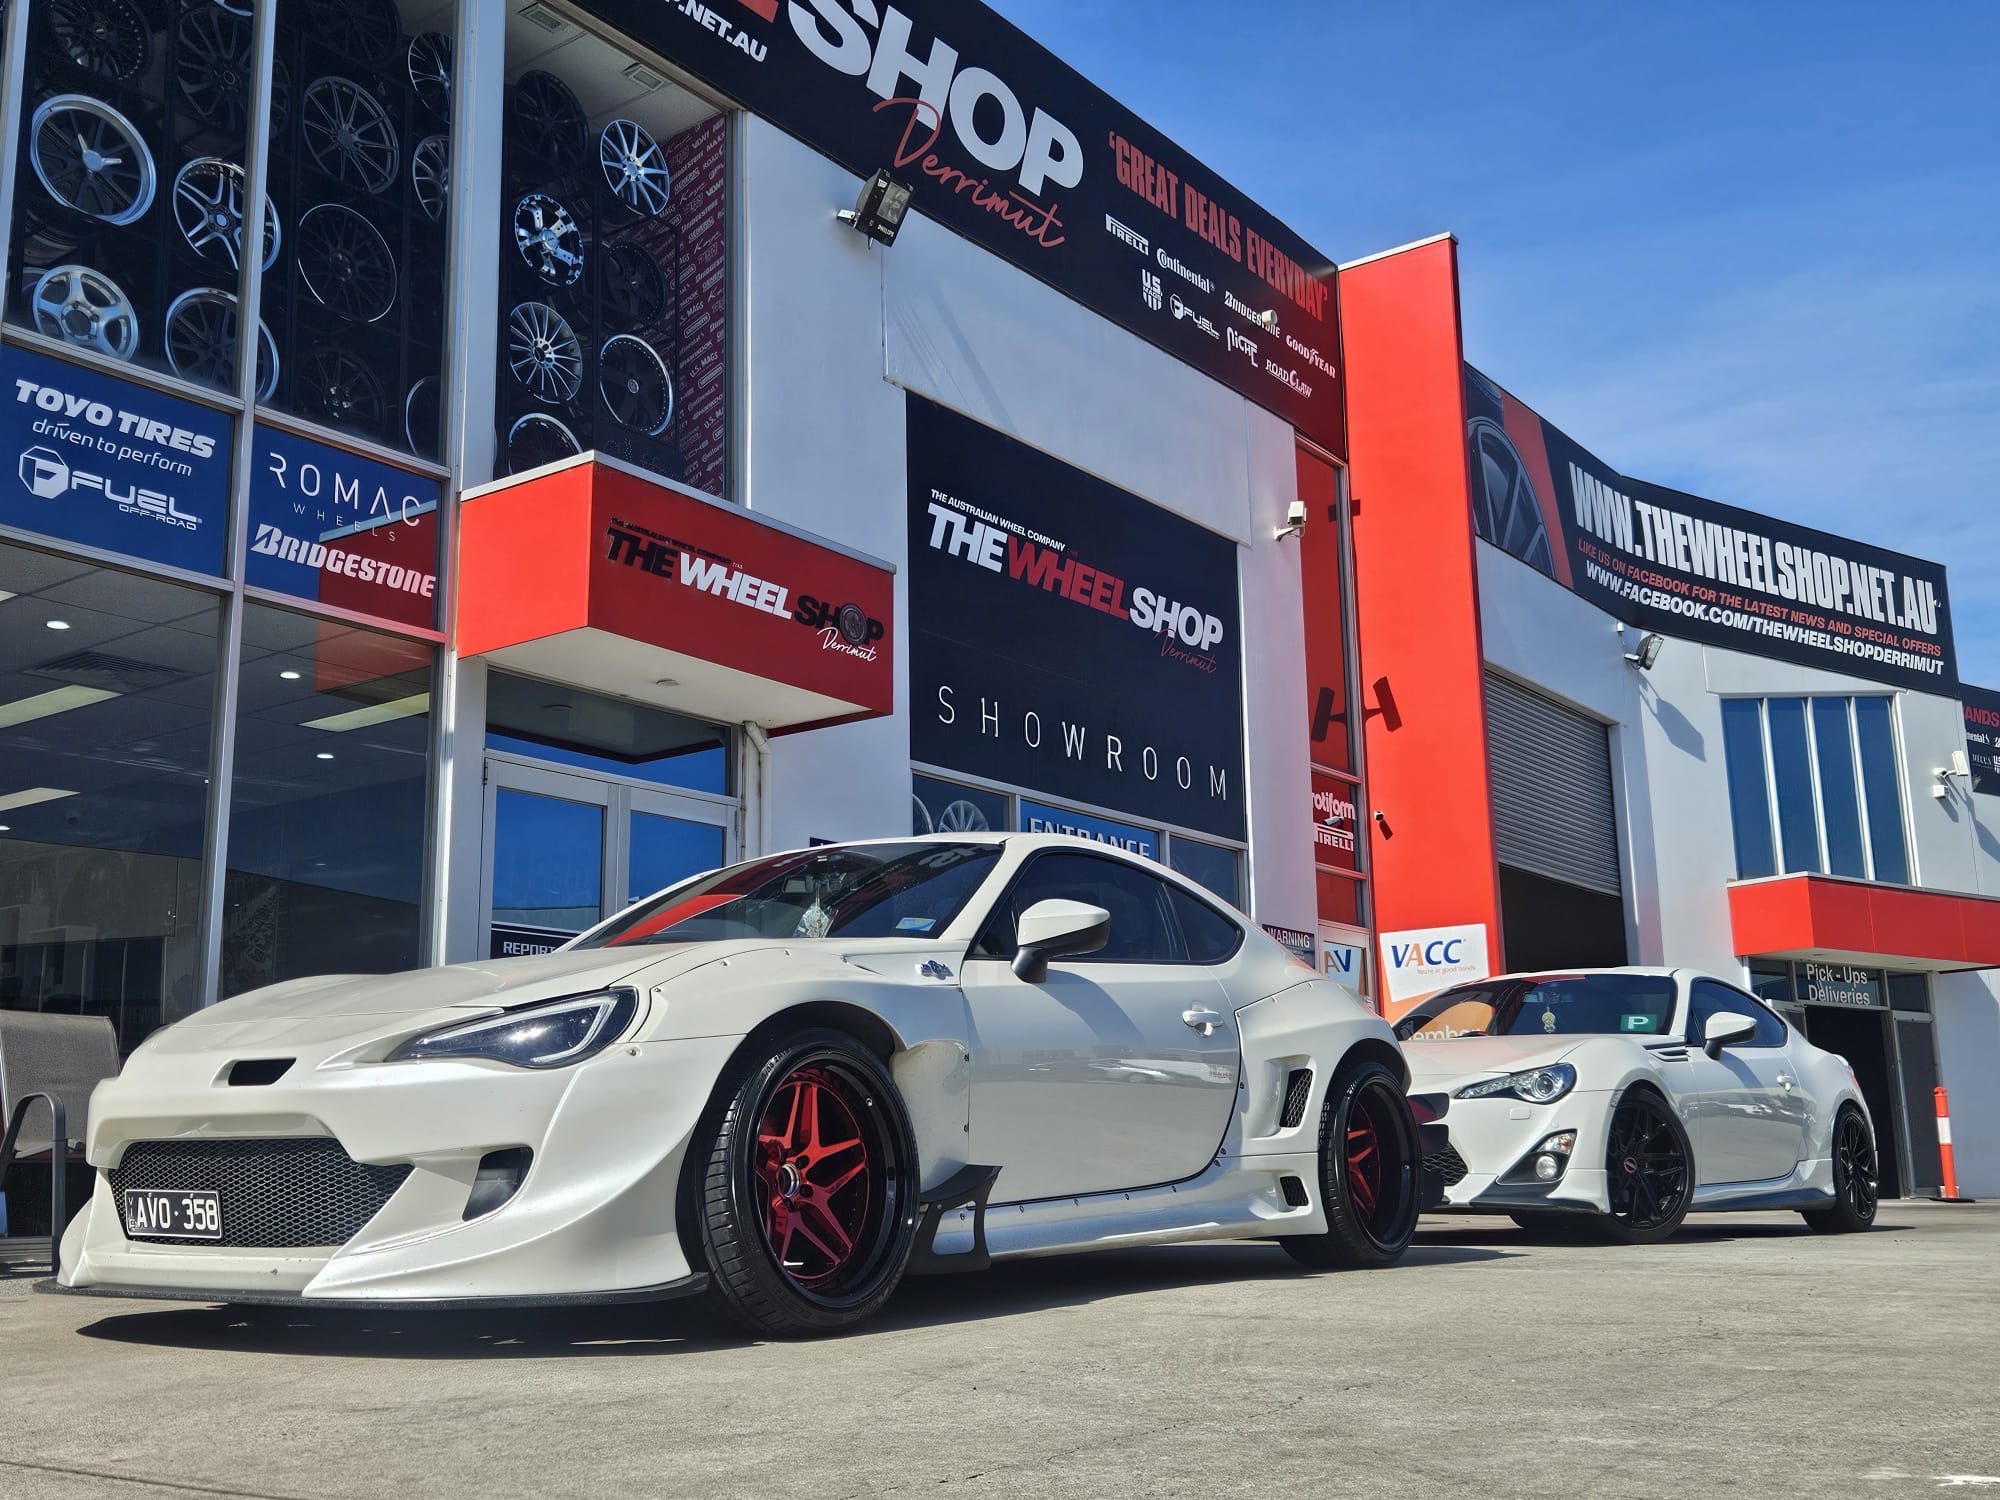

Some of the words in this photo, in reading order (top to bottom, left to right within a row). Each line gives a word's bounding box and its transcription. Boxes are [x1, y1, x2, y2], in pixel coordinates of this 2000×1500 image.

[676, 0, 768, 63] .NET.AU
[788, 0, 1084, 197] SHOP
[872, 97, 1066, 249] Derrimut
[1104, 213, 1150, 256] PIRELLI
[1184, 182, 1242, 264] DEALS
[1156, 248, 1210, 294] Continental
[1224, 290, 1282, 339] BRIDGESNE
[1285, 335, 1336, 379] GOODYEAR
[15, 378, 113, 428] TOYO
[117, 410, 216, 459] TIRES
[32, 418, 94, 448] driven
[97, 436, 116, 454] to
[117, 446, 193, 477] perform
[71, 470, 199, 523] FUEL
[119, 503, 197, 531] OFF-ROAD
[269, 451, 421, 527] ROMAC
[293, 503, 396, 542] WHEELS
[931, 487, 948, 504] THE
[947, 496, 999, 526] AUSTRALIAN
[999, 516, 1027, 537] WHEEL
[1027, 529, 1066, 553] COMPANY
[1568, 461, 1938, 636] WWW.THEWHEELSHOP.NET.AU
[250, 523, 437, 598] BRIDGESTONE
[607, 526, 680, 580] THE
[680, 551, 792, 620] WHEEL
[794, 594, 884, 646] SHOP
[927, 502, 1009, 574] THE
[1007, 534, 1130, 621] WHEEL
[1129, 586, 1224, 652] SHOP
[1578, 537, 1597, 561] LIKE
[1598, 551, 1611, 570] US
[1611, 558, 1626, 575] ON
[1627, 564, 1691, 596] FACEBOOK
[1691, 585, 1717, 604] FOR
[1718, 591, 1742, 609] THE
[1744, 599, 1789, 621] LATEST
[1790, 611, 1826, 630] NEWS
[1827, 619, 1852, 636] AND
[1854, 625, 1900, 648] SPECIAL
[1901, 637, 1942, 658] OFFERS
[1586, 559, 1945, 676] WWW.FACEBOOK.COM/THEWHEELSHOPDERRIMUT
[817, 626, 877, 662] Derrimut
[1154, 627, 1218, 675] Derrimut
[938, 685, 1227, 801] SHOWROOM
[1266, 926, 1311, 949] WARNING
[1391, 938, 1462, 969] VACC
[1806, 963, 1834, 983] Pick
[1843, 966, 1869, 988] Ups
[1808, 984, 1871, 1006] Deliveries
[1627, 1015, 1649, 1030] P
